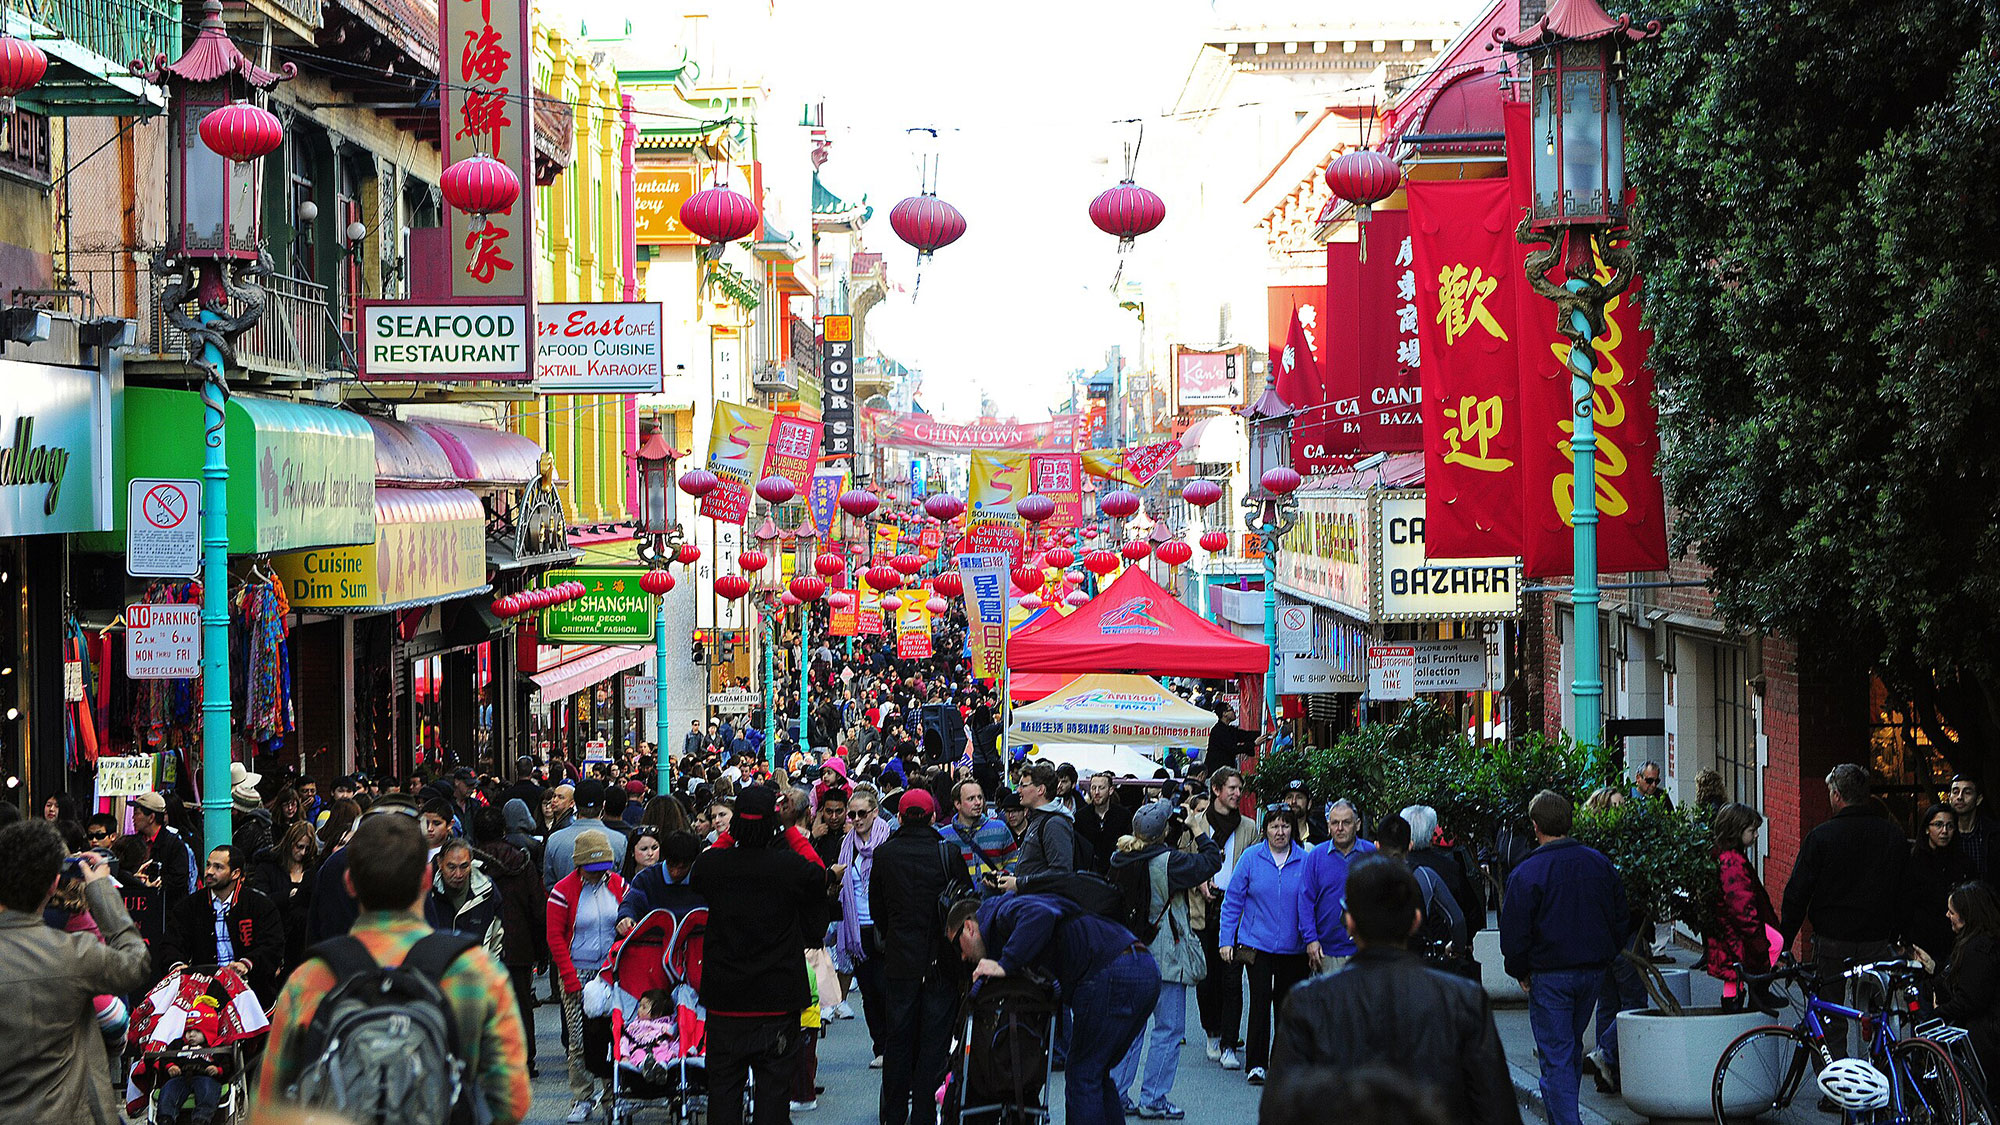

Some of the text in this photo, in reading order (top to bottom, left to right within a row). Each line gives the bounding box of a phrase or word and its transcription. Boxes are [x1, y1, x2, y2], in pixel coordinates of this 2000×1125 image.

[456, 0, 514, 284] 海鮮家
[377, 315, 514, 338] SEAFOOD
[564, 310, 625, 337] East
[625, 321, 656, 336] CAFÉ
[374, 345, 520, 362] RESTAURANT
[587, 360, 658, 376] KARAOKE
[1184, 357, 1225, 386] Kan's
[1437, 263, 1514, 472] 歡迎
[830, 343, 848, 409] FOUR
[1335, 400, 1360, 415] CA
[914, 425, 1023, 440] CHINATOWN
[0, 416, 69, 515] allery
[772, 454, 808, 471] BUSINESS
[281, 457, 328, 525] Hollywood
[724, 488, 746, 504] YEAR
[705, 495, 738, 511] FESTIVAL
[709, 507, 740, 521] PARADE
[971, 511, 1021, 521] SOUTHWEST
[970, 519, 1020, 528] AIRLINES
[1390, 517, 1425, 544] CA
[977, 527, 1014, 538] CHINESE
[970, 536, 1020, 547] NEW YEAR
[304, 552, 362, 574] Cuisine
[1390, 567, 1510, 595] BAZAAR
[293, 579, 368, 600] Dim Sum
[580, 596, 648, 613] SHANGHAI
[130, 608, 197, 628] NO PARKING
[973, 574, 1002, 674] 星島日報
[135, 631, 144, 644] 2
[172, 630, 179, 644] 6
[135, 650, 153, 660] MON
[176, 649, 190, 660] FRI
[1372, 648, 1411, 656] TOW-AWAY
[1433, 654, 1480, 664] Furniture
[135, 666, 194, 674] STREET CLEANING
[1368, 657, 1413, 668] NO STOPPING
[1292, 674, 1305, 682] WE
[1308, 674, 1327, 683] SHIP
[1382, 670, 1401, 679] ANY
[1415, 668, 1460, 677] ollection
[1382, 680, 1401, 689] TIME
[709, 693, 759, 703] SACRAMENTO
[1112, 725, 1134, 737] Sing
[1134, 725, 1151, 736] Tao
[1152, 726, 1189, 737] Chinese
[100, 759, 150, 769] SUPER SALE
